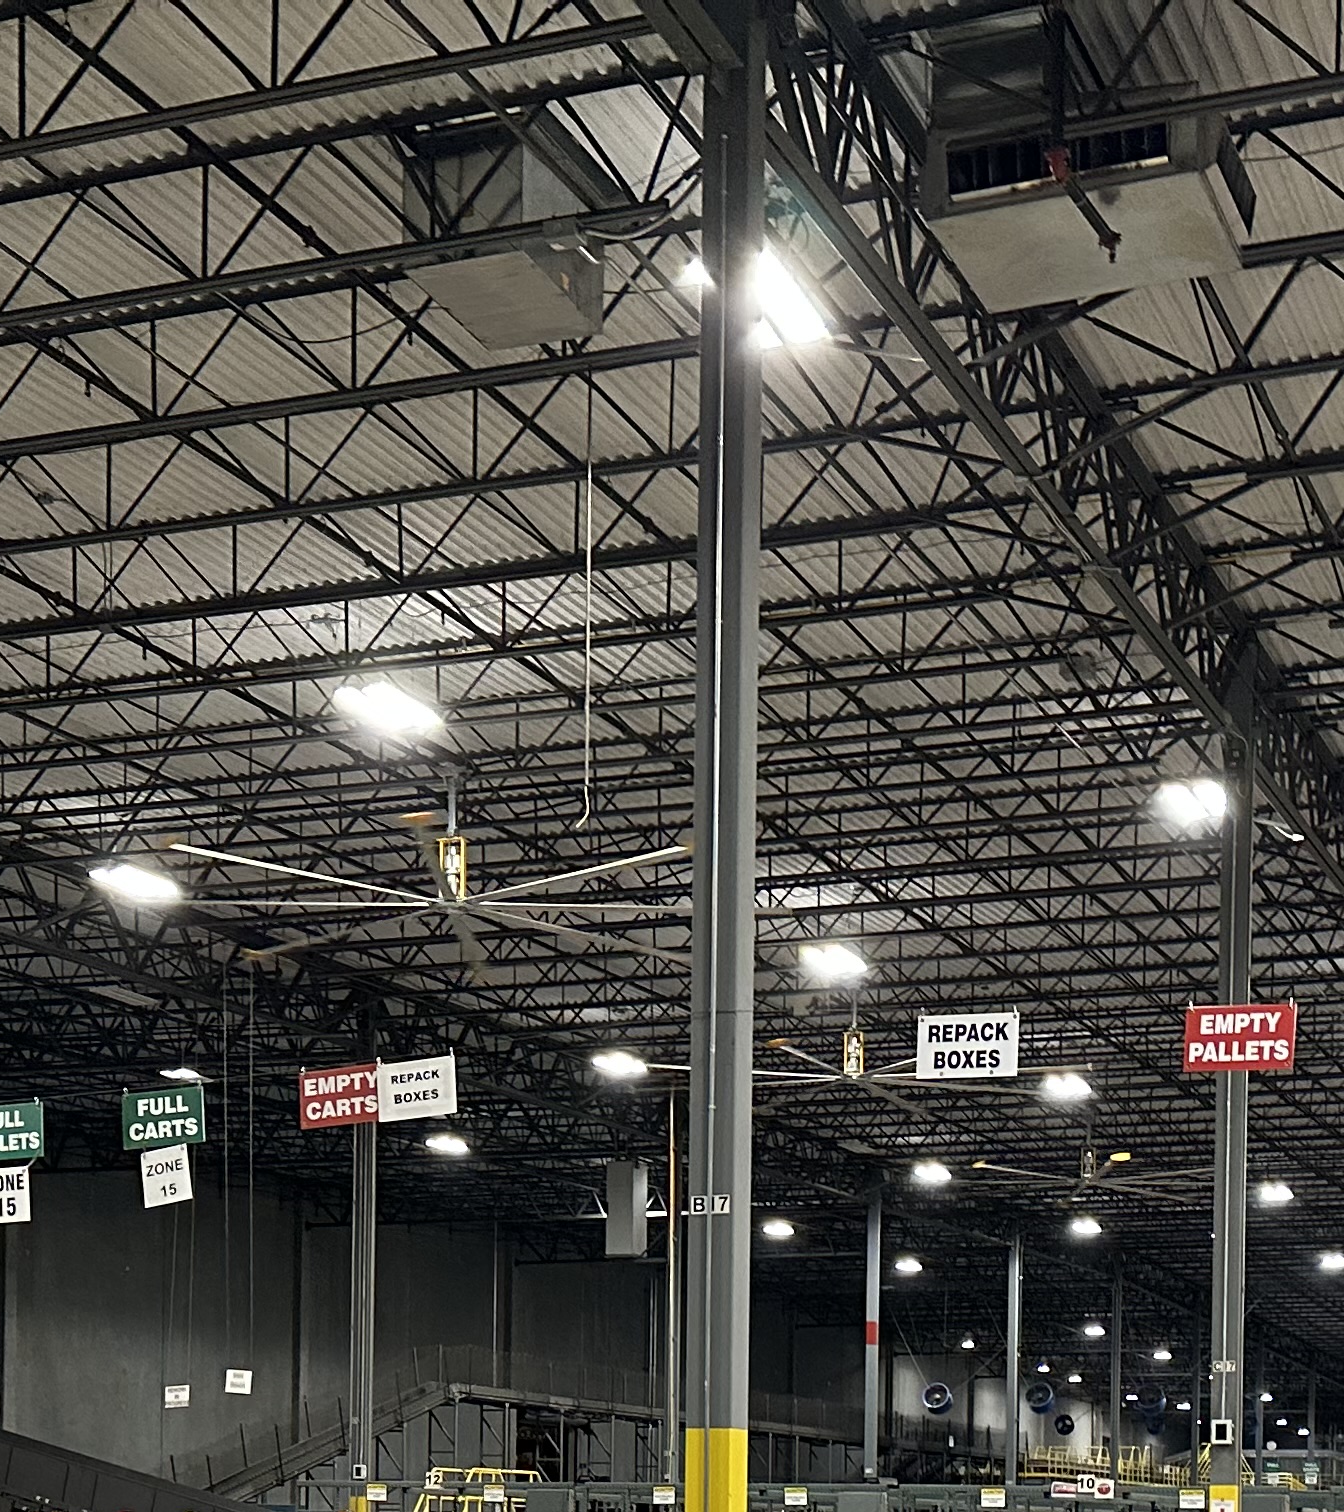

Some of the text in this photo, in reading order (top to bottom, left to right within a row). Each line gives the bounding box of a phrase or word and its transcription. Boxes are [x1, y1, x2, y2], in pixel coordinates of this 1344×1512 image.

[928, 1022, 1009, 1043] REPACK
[1200, 1012, 1282, 1035] EMPTY
[934, 1049, 1000, 1069] BOXES
[1188, 1039, 1289, 1063] PALLETS
[303, 1070, 377, 1097] EMPTY
[391, 1069, 440, 1085] REPACK
[137, 1095, 189, 1117] FULL
[394, 1088, 439, 1105] BOXES
[306, 1095, 378, 1121] CARTS
[129, 1117, 198, 1141] CARTS
[146, 1158, 184, 1177] ZONE
[160, 1183, 177, 1197] 15
[426, 1474, 440, 1485] 12
[1078, 1477, 1095, 1489] 10
